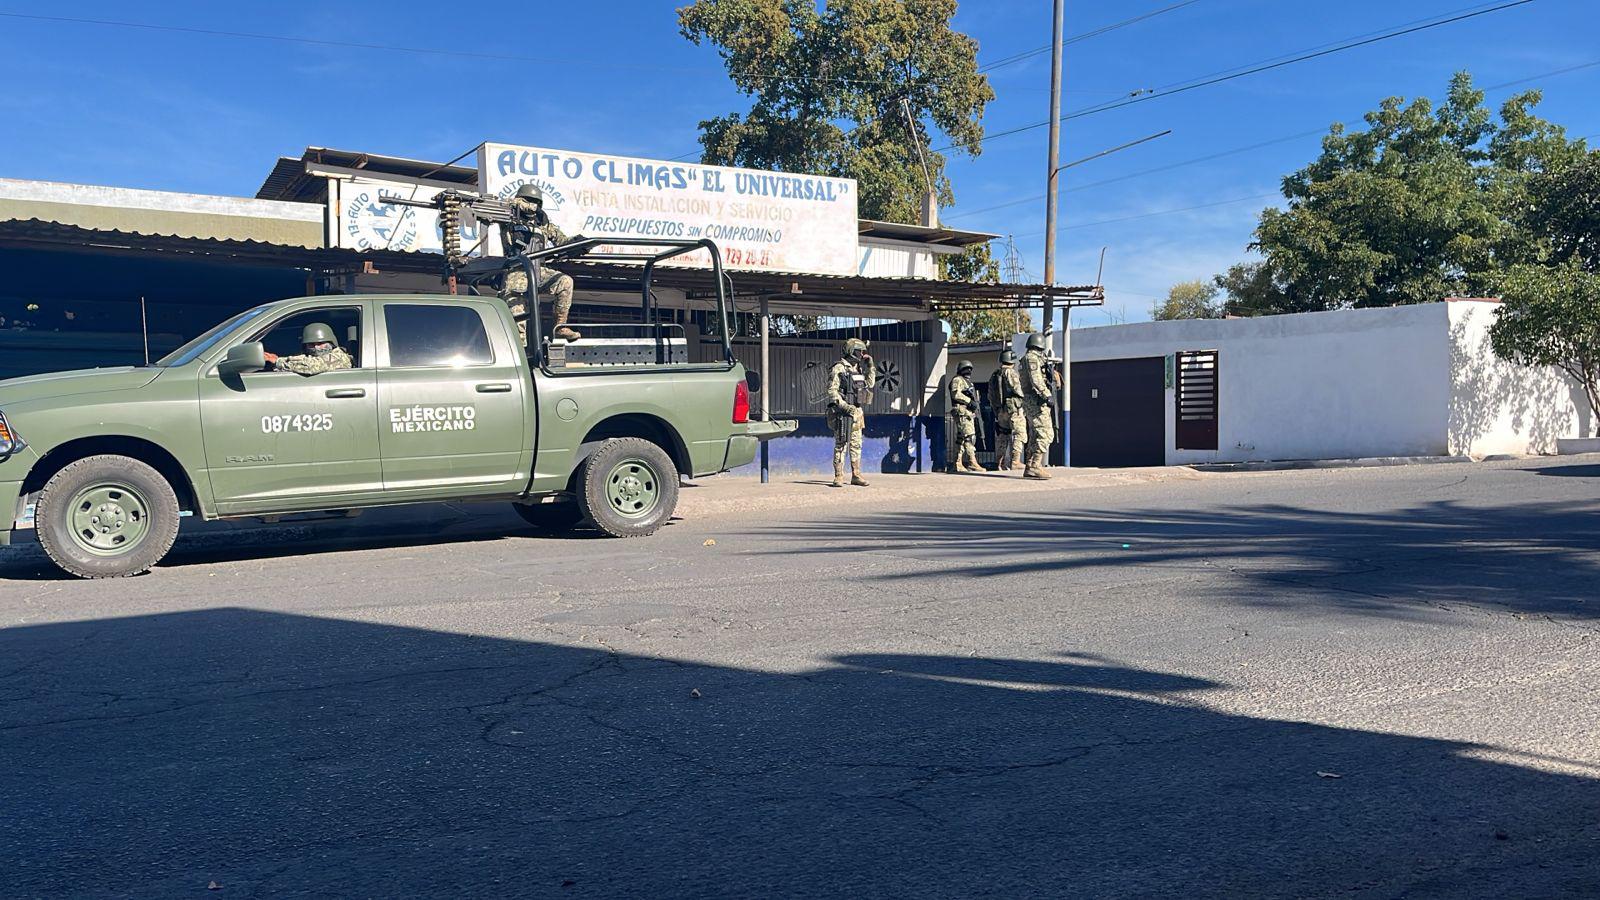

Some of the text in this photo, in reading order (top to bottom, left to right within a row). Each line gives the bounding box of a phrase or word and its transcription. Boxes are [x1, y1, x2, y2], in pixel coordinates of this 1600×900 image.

[497, 150, 583, 179] AUTO
[592, 160, 688, 190] CLIMAS
[348, 188, 416, 219] AUTO CLIS
[498, 178, 566, 205] AUTO CLIMAS
[573, 190, 793, 221] VENTA INSTALACION Y SERVICIO
[583, 215, 782, 243] PRESUPUESTOS SIN COMPROMISO
[261, 413, 333, 433] 0874325
[390, 405, 475, 422] EJÉRCITO
[392, 420, 475, 433] MEXICANO
